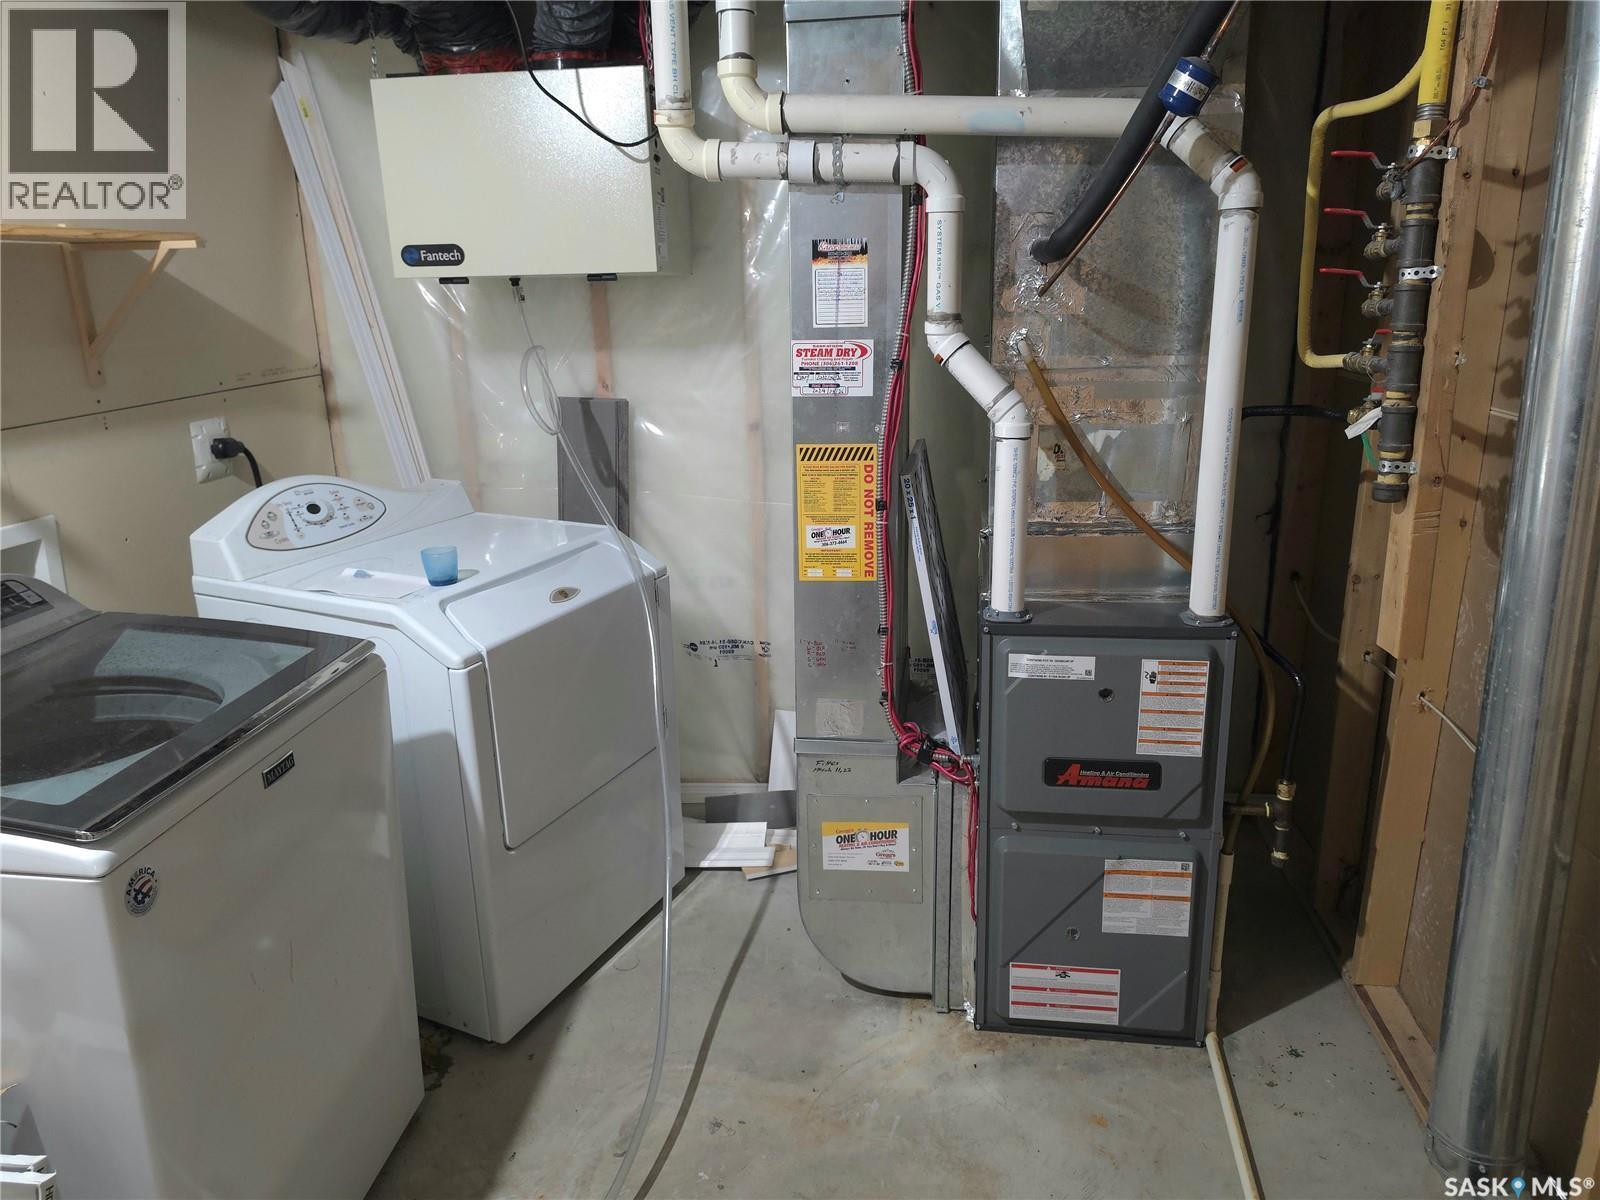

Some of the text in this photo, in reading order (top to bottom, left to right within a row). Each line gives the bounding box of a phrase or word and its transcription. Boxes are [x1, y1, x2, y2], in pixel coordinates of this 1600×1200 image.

[668, 13, 677, 37] VENT
[670, 41, 678, 66] TYPE
[420, 249, 462, 262] Fantech
[796, 347, 858, 358] STEAM DRY
[903, 478, 911, 489] 20
[906, 496, 915, 508] 25
[863, 464, 875, 578] DO NOT REMOVE
[910, 514, 917, 522] 1
[811, 530, 824, 539] ONE
[832, 527, 851, 536] HOUR
[265, 754, 295, 787] MAYTAG
[1055, 763, 1152, 788] Amana
[1079, 769, 1101, 778] Heating
[1115, 770, 1150, 779] Conditioning
[836, 829, 898, 844] ONE HOUR
